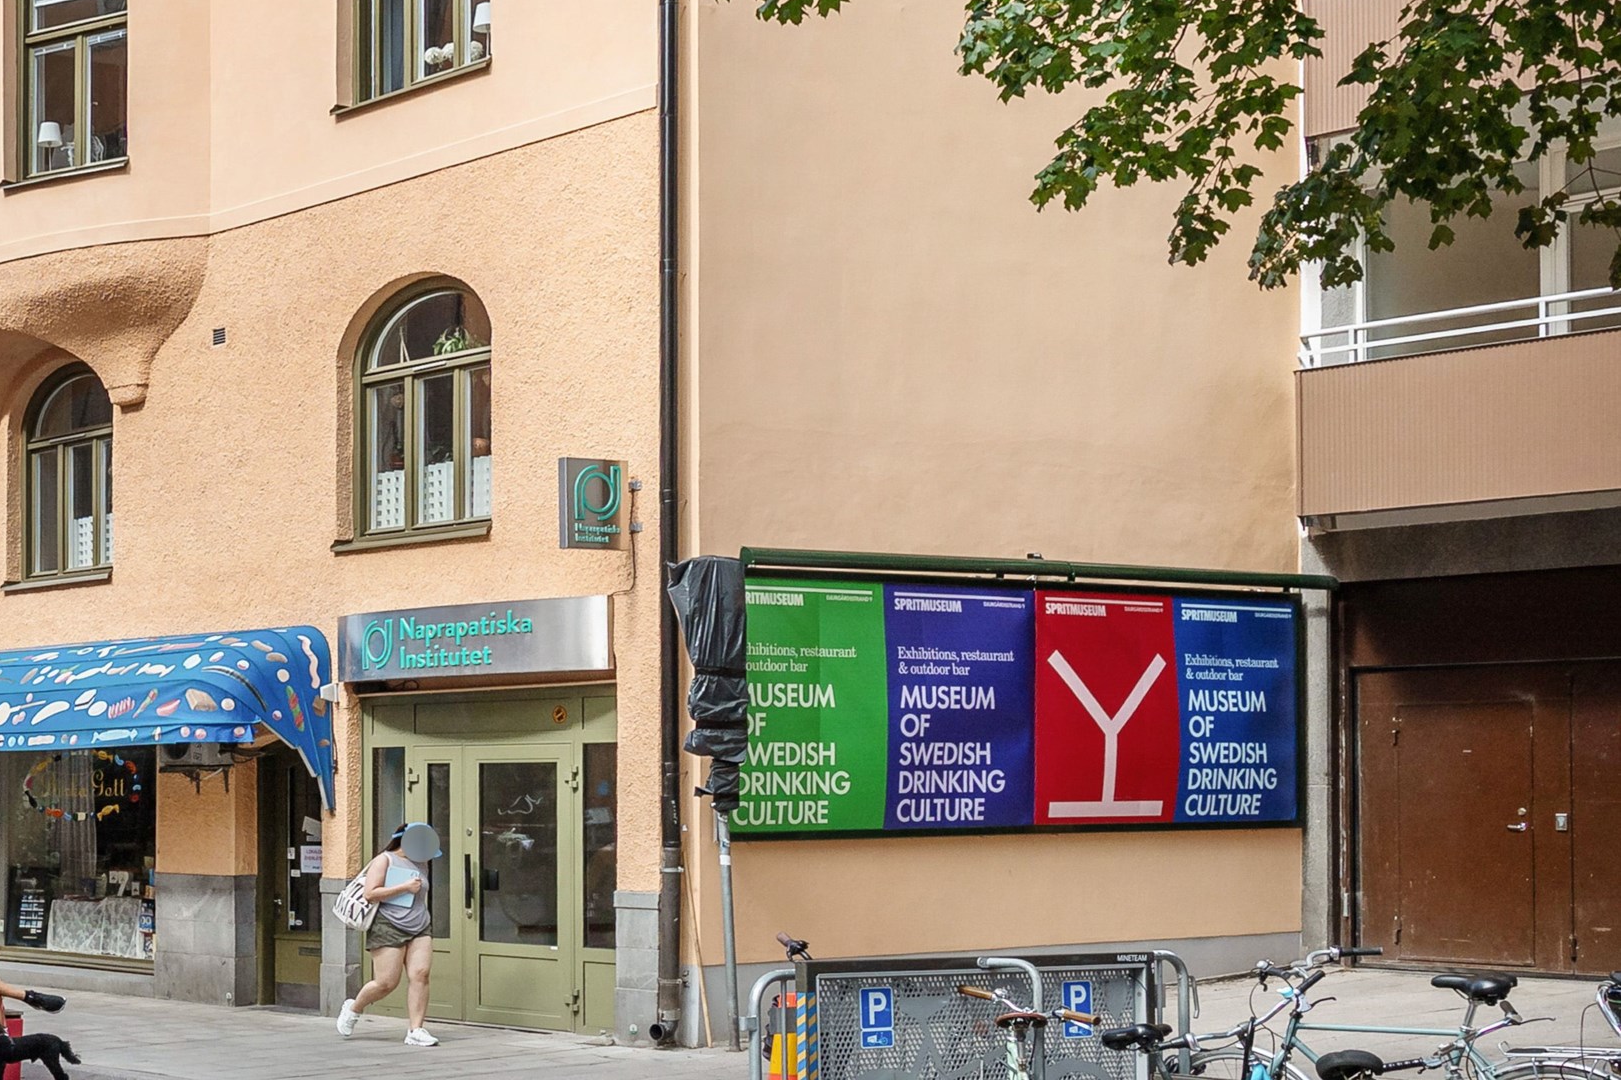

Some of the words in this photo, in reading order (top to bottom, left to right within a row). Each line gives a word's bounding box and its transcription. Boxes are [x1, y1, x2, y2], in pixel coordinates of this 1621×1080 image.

[745, 592, 804, 606] RITMUSEUM
[894, 598, 962, 612] SPRITMUSEUM
[1045, 602, 1107, 617] SPRITMUSEUM
[1181, 609, 1238, 623] SPRITMUSEUM
[399, 610, 533, 647] Naprapatiska
[400, 644, 492, 669] Institutet
[746, 642, 798, 658] hibitions,
[800, 646, 857, 658] restaurant
[897, 646, 959, 662] Exhibitions,
[961, 650, 1015, 662] restaurant
[1185, 654, 1234, 668] Exhibitions,
[1236, 658, 1279, 668] restaurant
[746, 658, 788, 672] outdoor
[790, 659, 808, 672] bar
[898, 662, 908, 674] &
[910, 662, 951, 675] outdoor
[952, 663, 970, 675] bar
[1186, 667, 1194, 680] &
[1196, 668, 1227, 680] outdoor
[1228, 669, 1244, 681] bar
[900, 685, 996, 710] MUSEUM
[1188, 689, 1266, 712] MUSEUM
[900, 713, 931, 737] OF
[1188, 715, 1215, 738] OF
[740, 742, 836, 766] WEDISH
[899, 742, 991, 766] SWEDISH
[1189, 742, 1268, 764] SWEDISH
[91, 770, 126, 796] Gott
[739, 771, 851, 796] DRINKING
[898, 770, 1006, 794] DRINKING
[1188, 768, 1277, 790] DRINKING
[732, 800, 829, 826] CULTURE
[896, 798, 985, 823] CULTURE
[1185, 794, 1262, 816] CULTURE
[1117, 954, 1148, 962] MINETEAM
[868, 992, 886, 1026] P
[1070, 984, 1086, 1012] P
